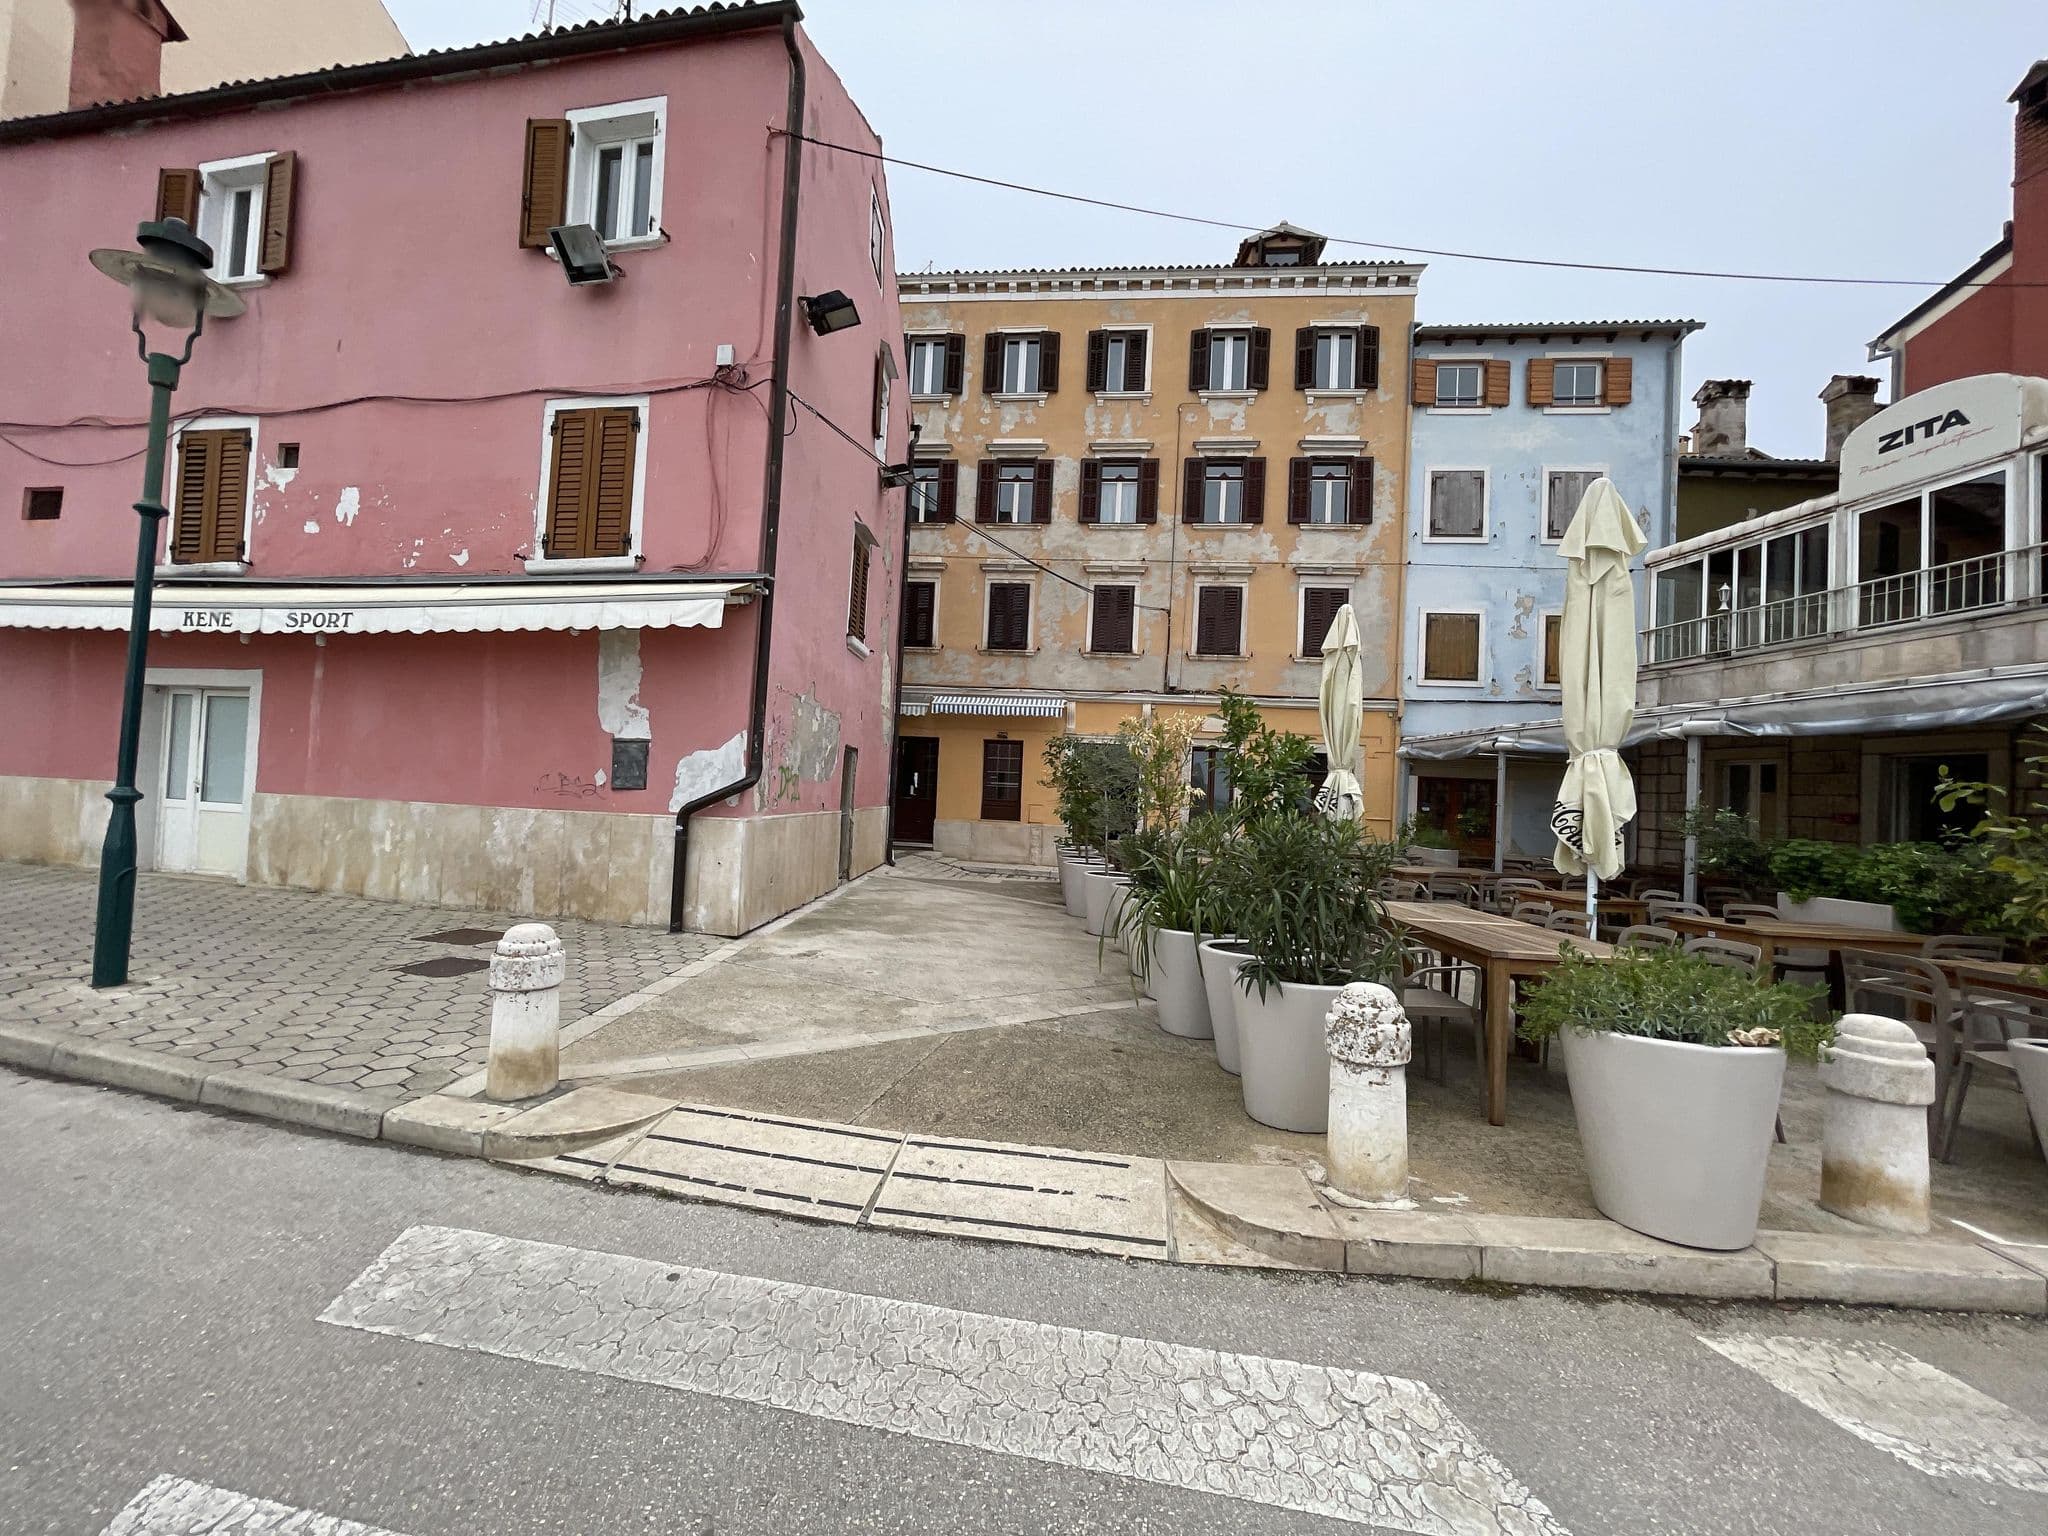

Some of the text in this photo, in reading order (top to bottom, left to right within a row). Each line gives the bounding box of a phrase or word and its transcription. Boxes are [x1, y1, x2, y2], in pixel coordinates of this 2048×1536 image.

[1878, 409, 1971, 455] ZITA
[182, 611, 354, 628] KENE SPORT
